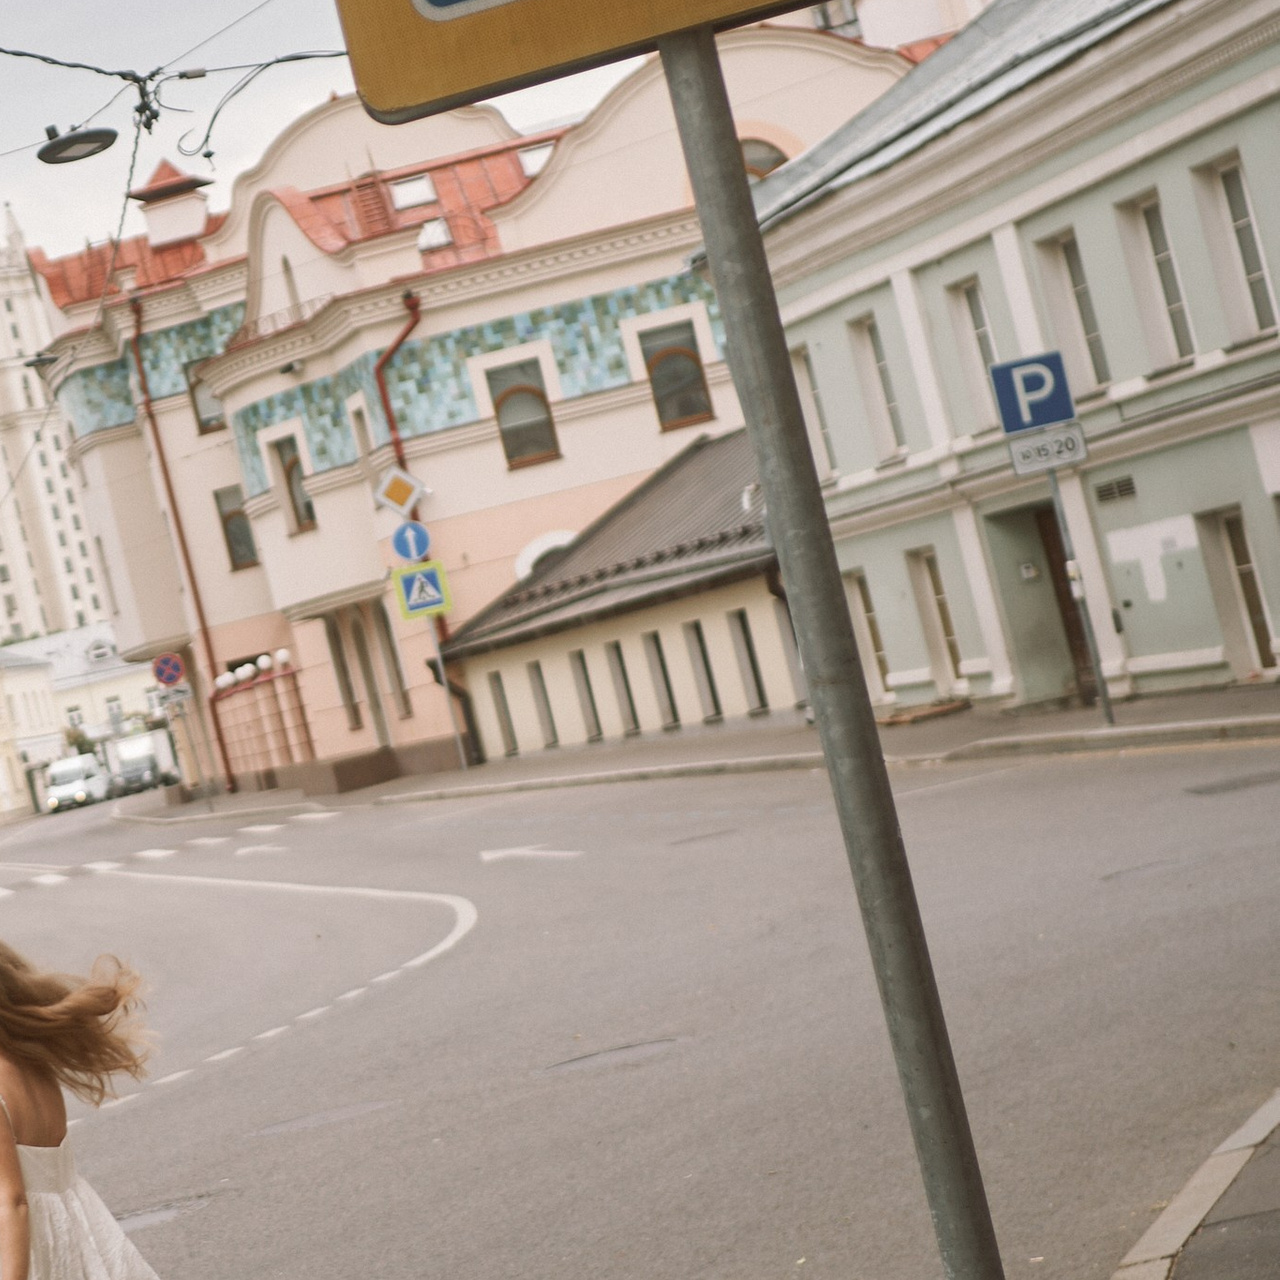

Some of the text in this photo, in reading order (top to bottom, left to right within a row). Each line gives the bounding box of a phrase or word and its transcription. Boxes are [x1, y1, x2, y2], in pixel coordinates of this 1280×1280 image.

[1011, 362, 1055, 425] P
[1036, 443, 1050, 458] 15
[1054, 436, 1076, 455] 20
